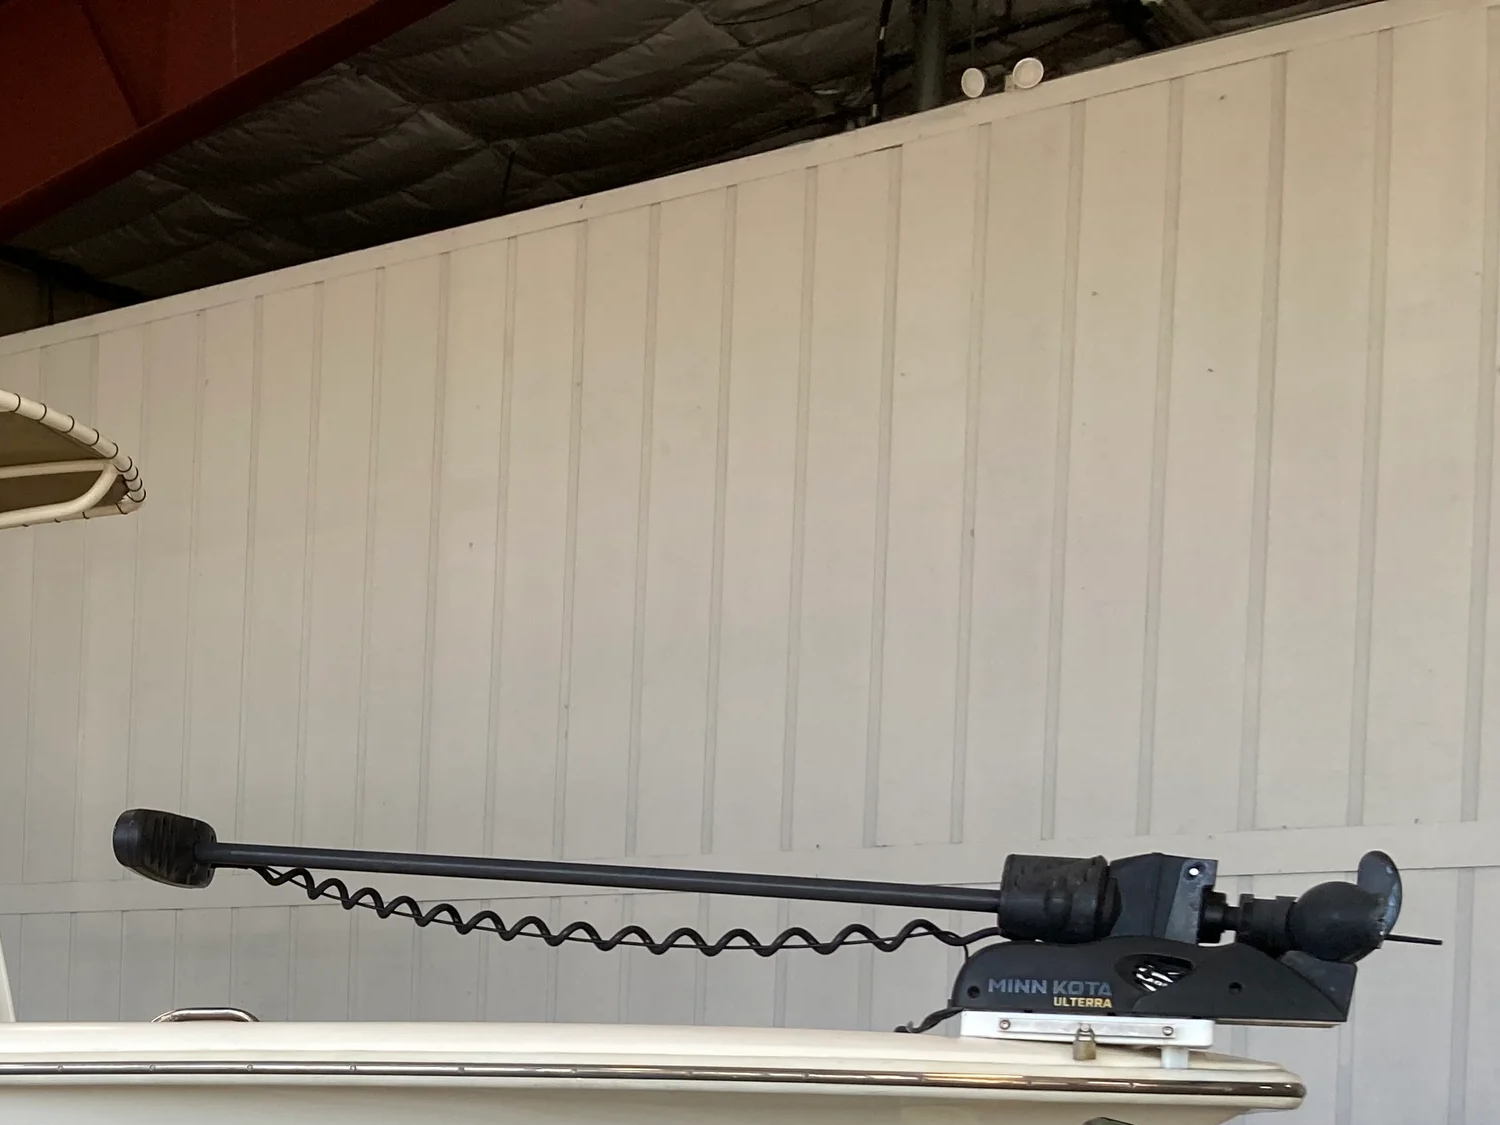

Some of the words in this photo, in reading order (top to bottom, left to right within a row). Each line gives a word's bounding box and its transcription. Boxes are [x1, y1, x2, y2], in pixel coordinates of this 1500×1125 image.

[988, 978, 1047, 994] MINN
[1053, 980, 1112, 997] KOTA
[1053, 996, 1112, 1009] ULTERRA
